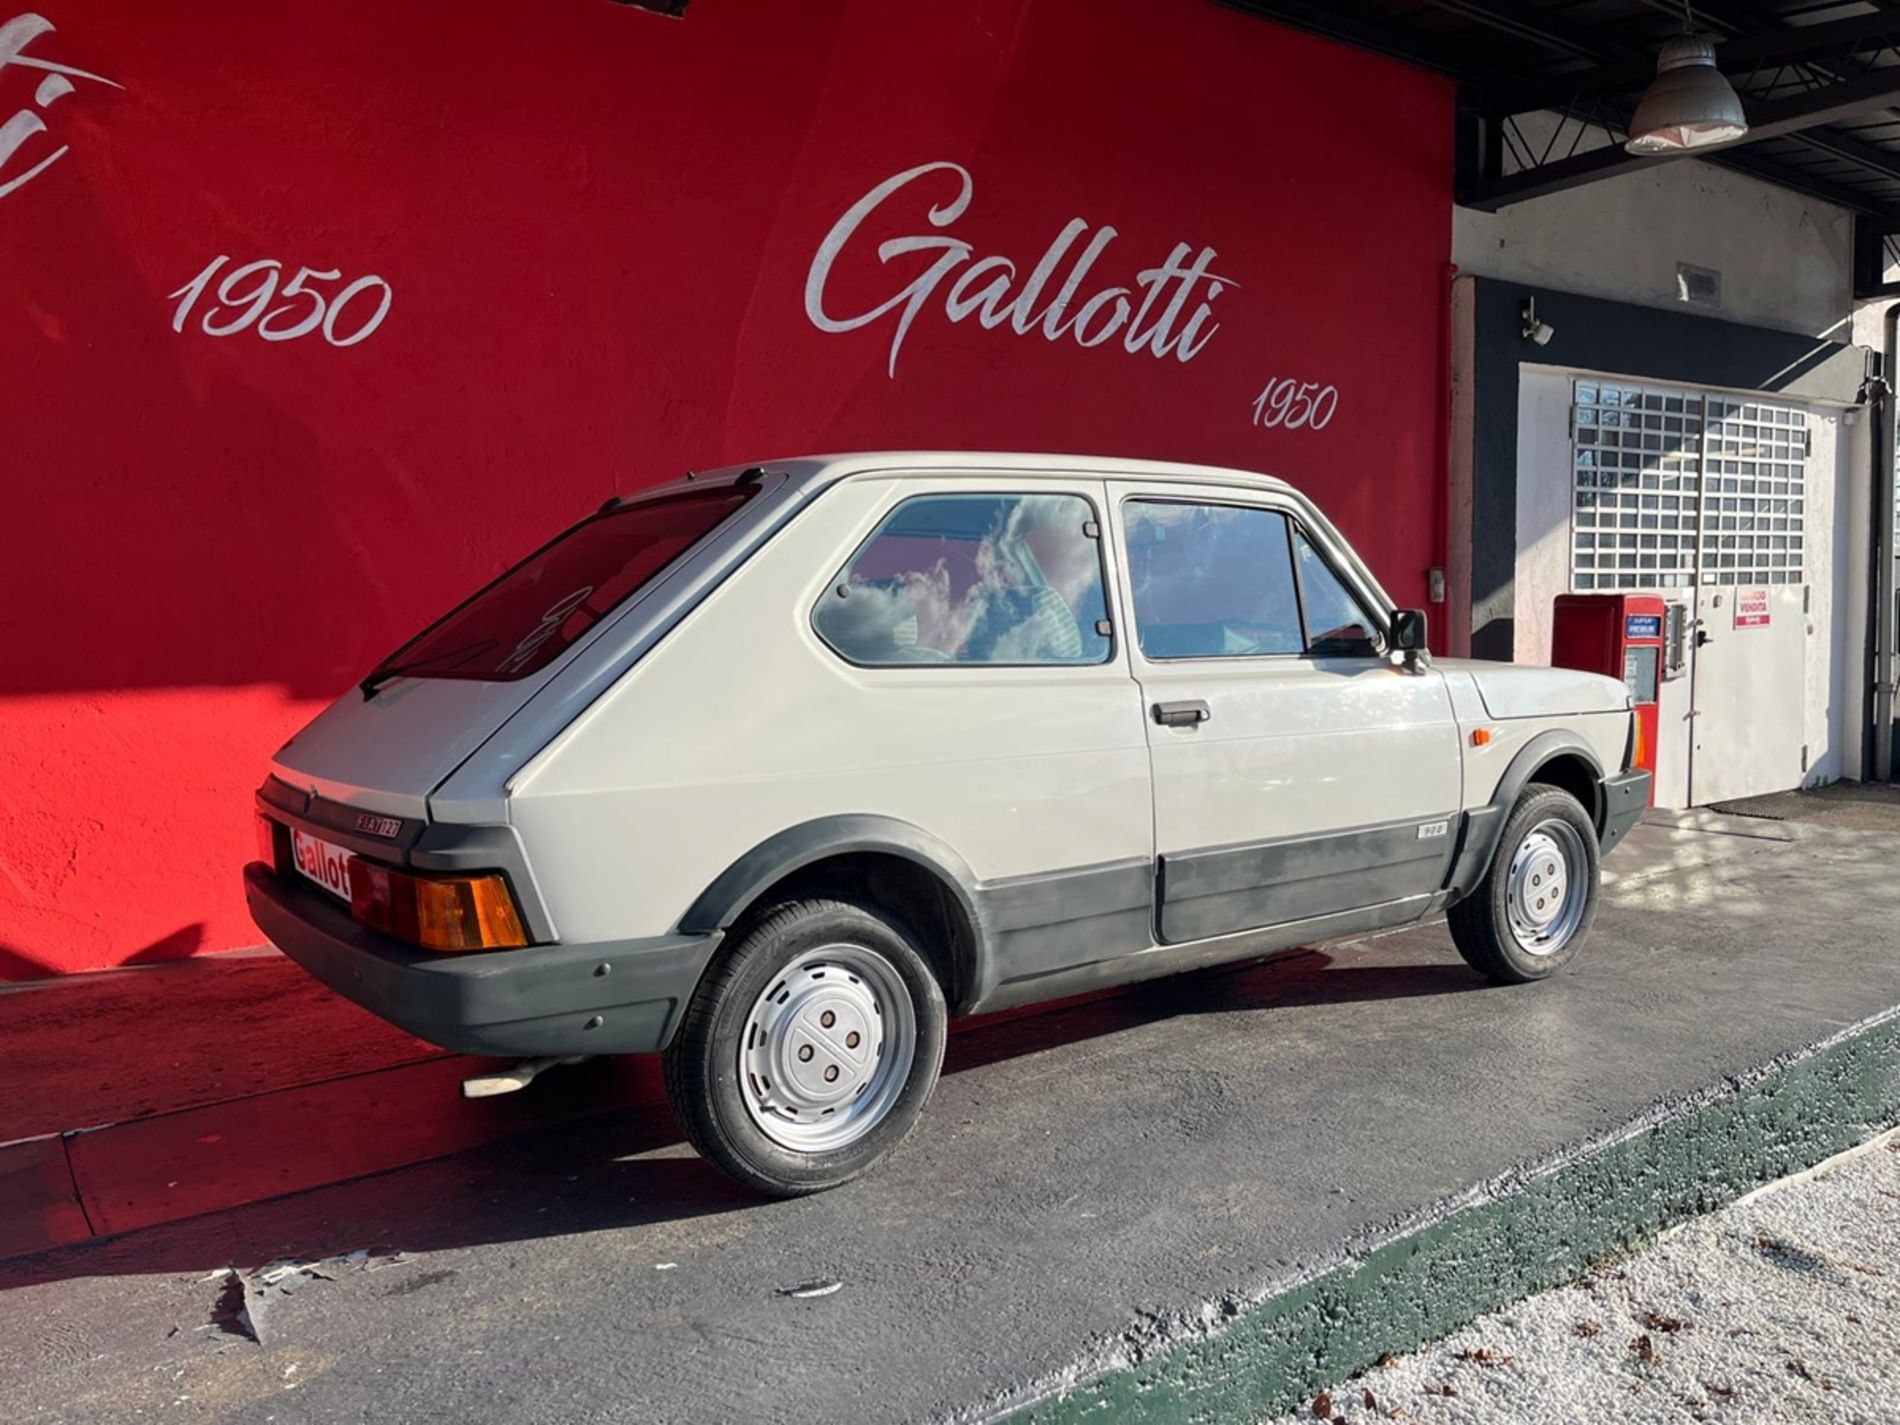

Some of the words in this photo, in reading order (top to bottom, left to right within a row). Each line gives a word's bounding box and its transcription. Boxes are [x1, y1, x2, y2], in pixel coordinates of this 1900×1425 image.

[168, 255, 393, 346] 1950
[805, 161, 1239, 378] Gallotti
[1253, 377, 1339, 430] 1950
[357, 816, 383, 833] FIAT
[382, 819, 401, 837] 127
